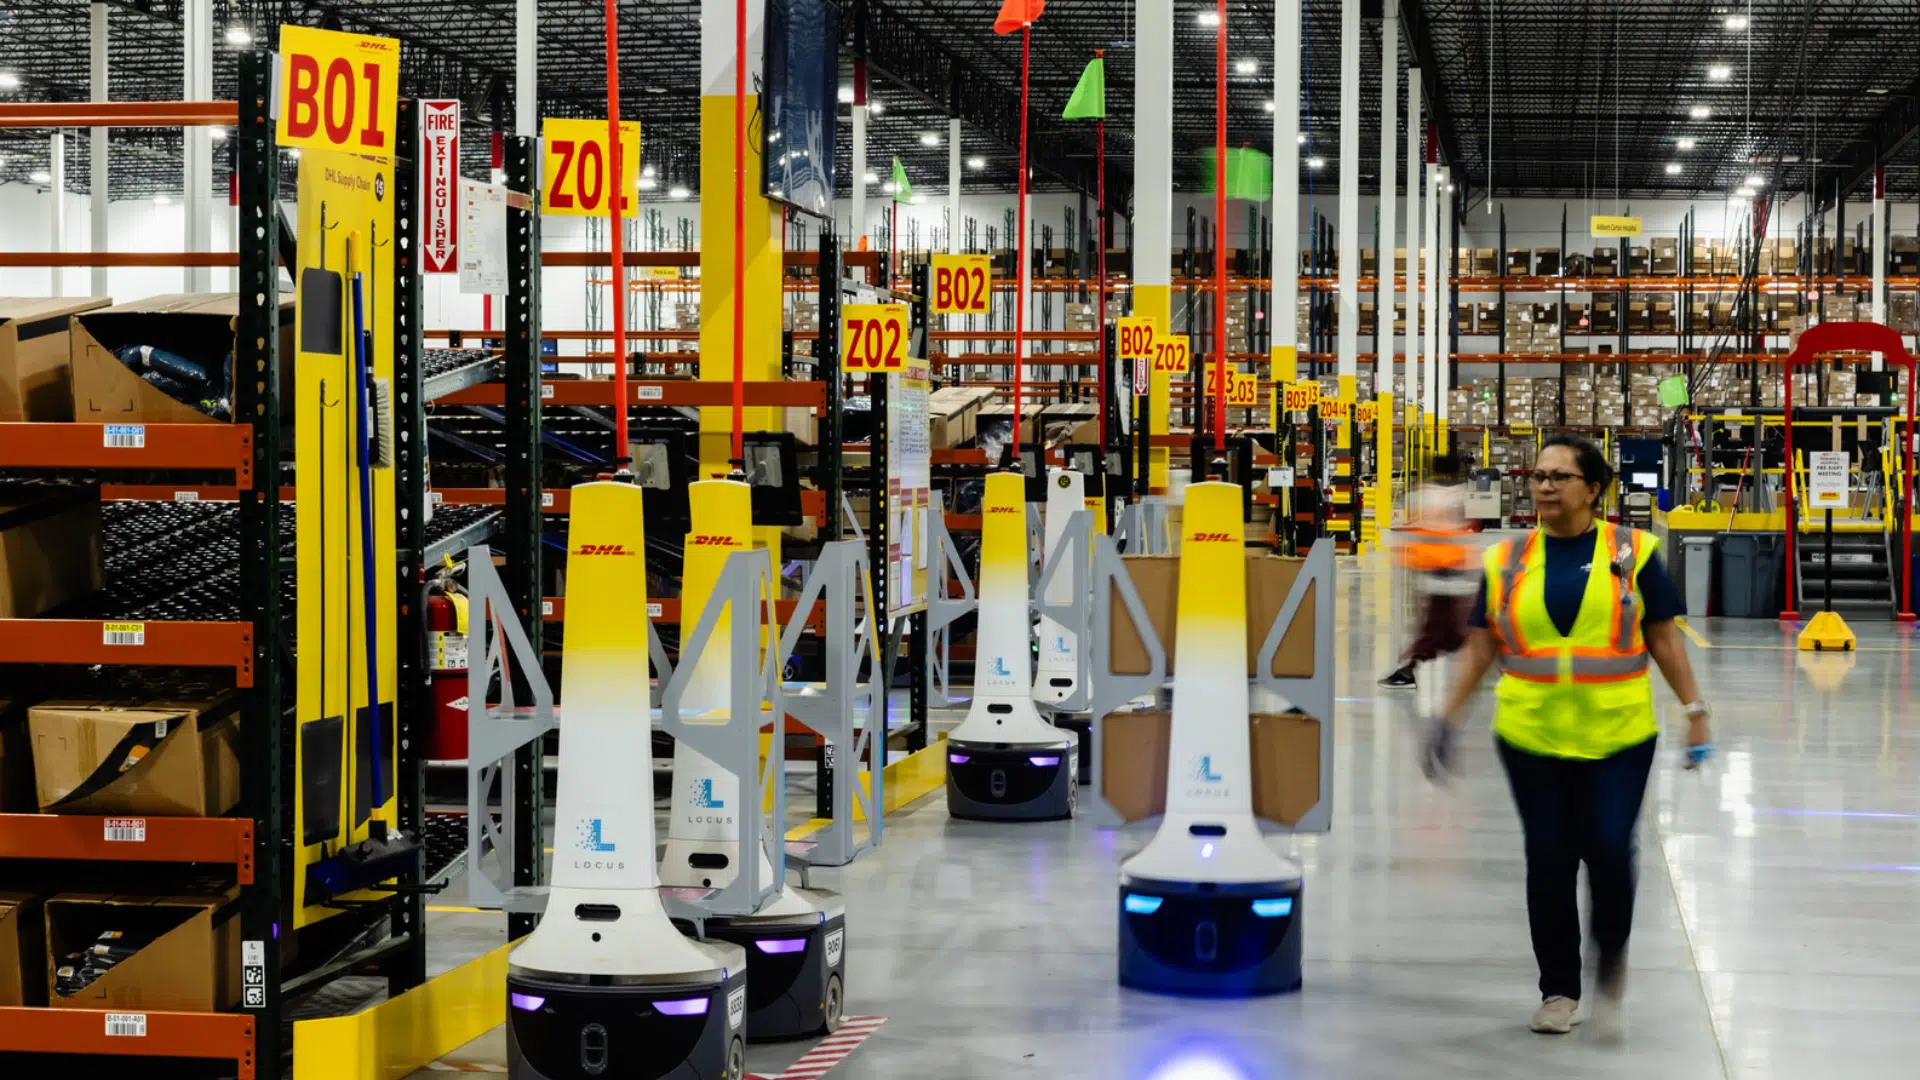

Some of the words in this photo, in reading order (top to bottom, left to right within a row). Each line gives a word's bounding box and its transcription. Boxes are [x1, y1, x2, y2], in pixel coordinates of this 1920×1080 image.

[287, 53, 385, 148] B01
[427, 114, 455, 130] FIRE
[337, 170, 355, 192] Supply
[356, 175, 371, 191] Chain
[375, 178, 384, 196] 15
[435, 136, 446, 259] EXTINGUISHER
[937, 267, 985, 310] B02
[846, 319, 901, 368] Z02
[1121, 326, 1153, 355] B02
[1155, 344, 1186, 371] Z02
[1207, 370, 1234, 394] Z3
[1230, 381, 1254, 402] 03
[1286, 391, 1307, 409] B03
[1320, 402, 1339, 417] Z04
[1358, 408, 1372, 421] B04
[694, 535, 736, 546] DHL
[1193, 533, 1230, 542] DHL
[579, 544, 627, 556] DHL
[688, 816, 733, 824] LOCUS
[574, 861, 625, 869] LOCUS
